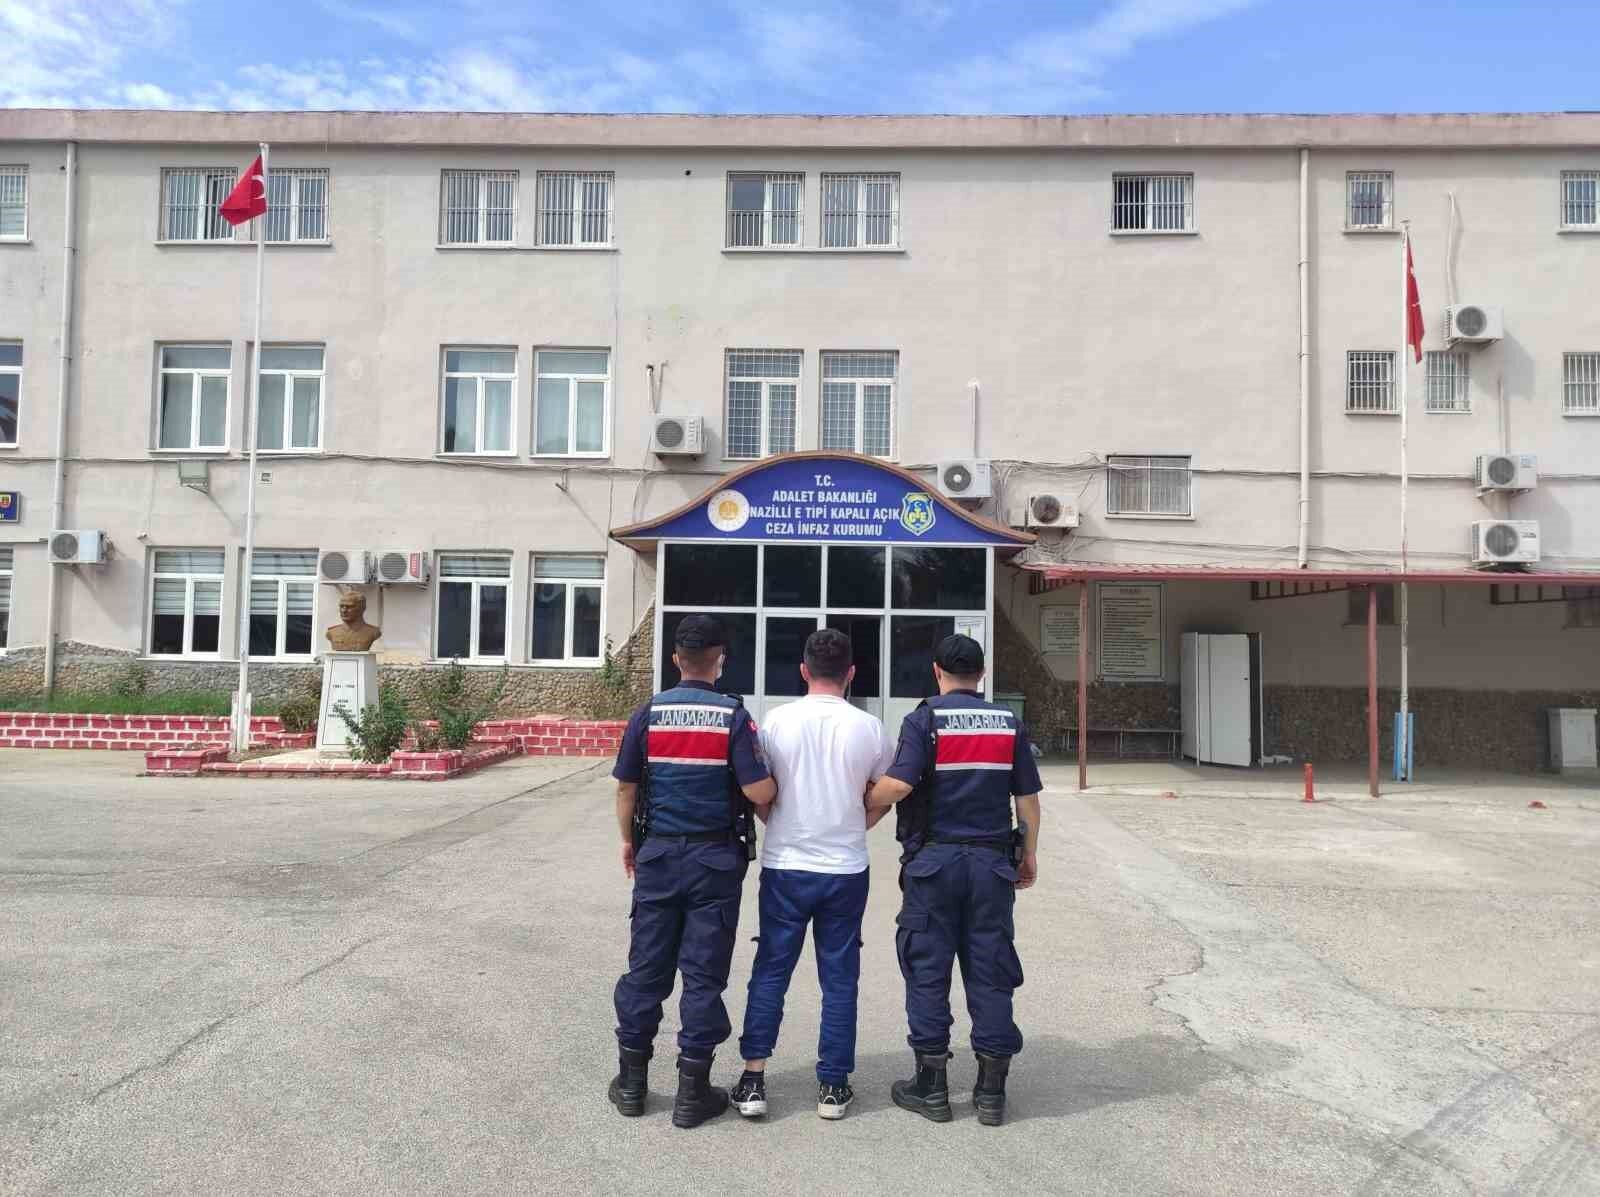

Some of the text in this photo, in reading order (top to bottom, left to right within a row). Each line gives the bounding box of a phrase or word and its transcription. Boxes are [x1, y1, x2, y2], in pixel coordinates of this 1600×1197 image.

[814, 475, 835, 487] T.C.
[772, 489, 877, 503] ADALET BAKANLIĞI
[749, 505, 900, 522] NAZİLLİ E TİPİ KAPALI AÇIK
[765, 521, 883, 536] CEZA İNFAZ KURUMU
[656, 710, 725, 727] JANDARMA
[944, 714, 1009, 729] JANDARMA
